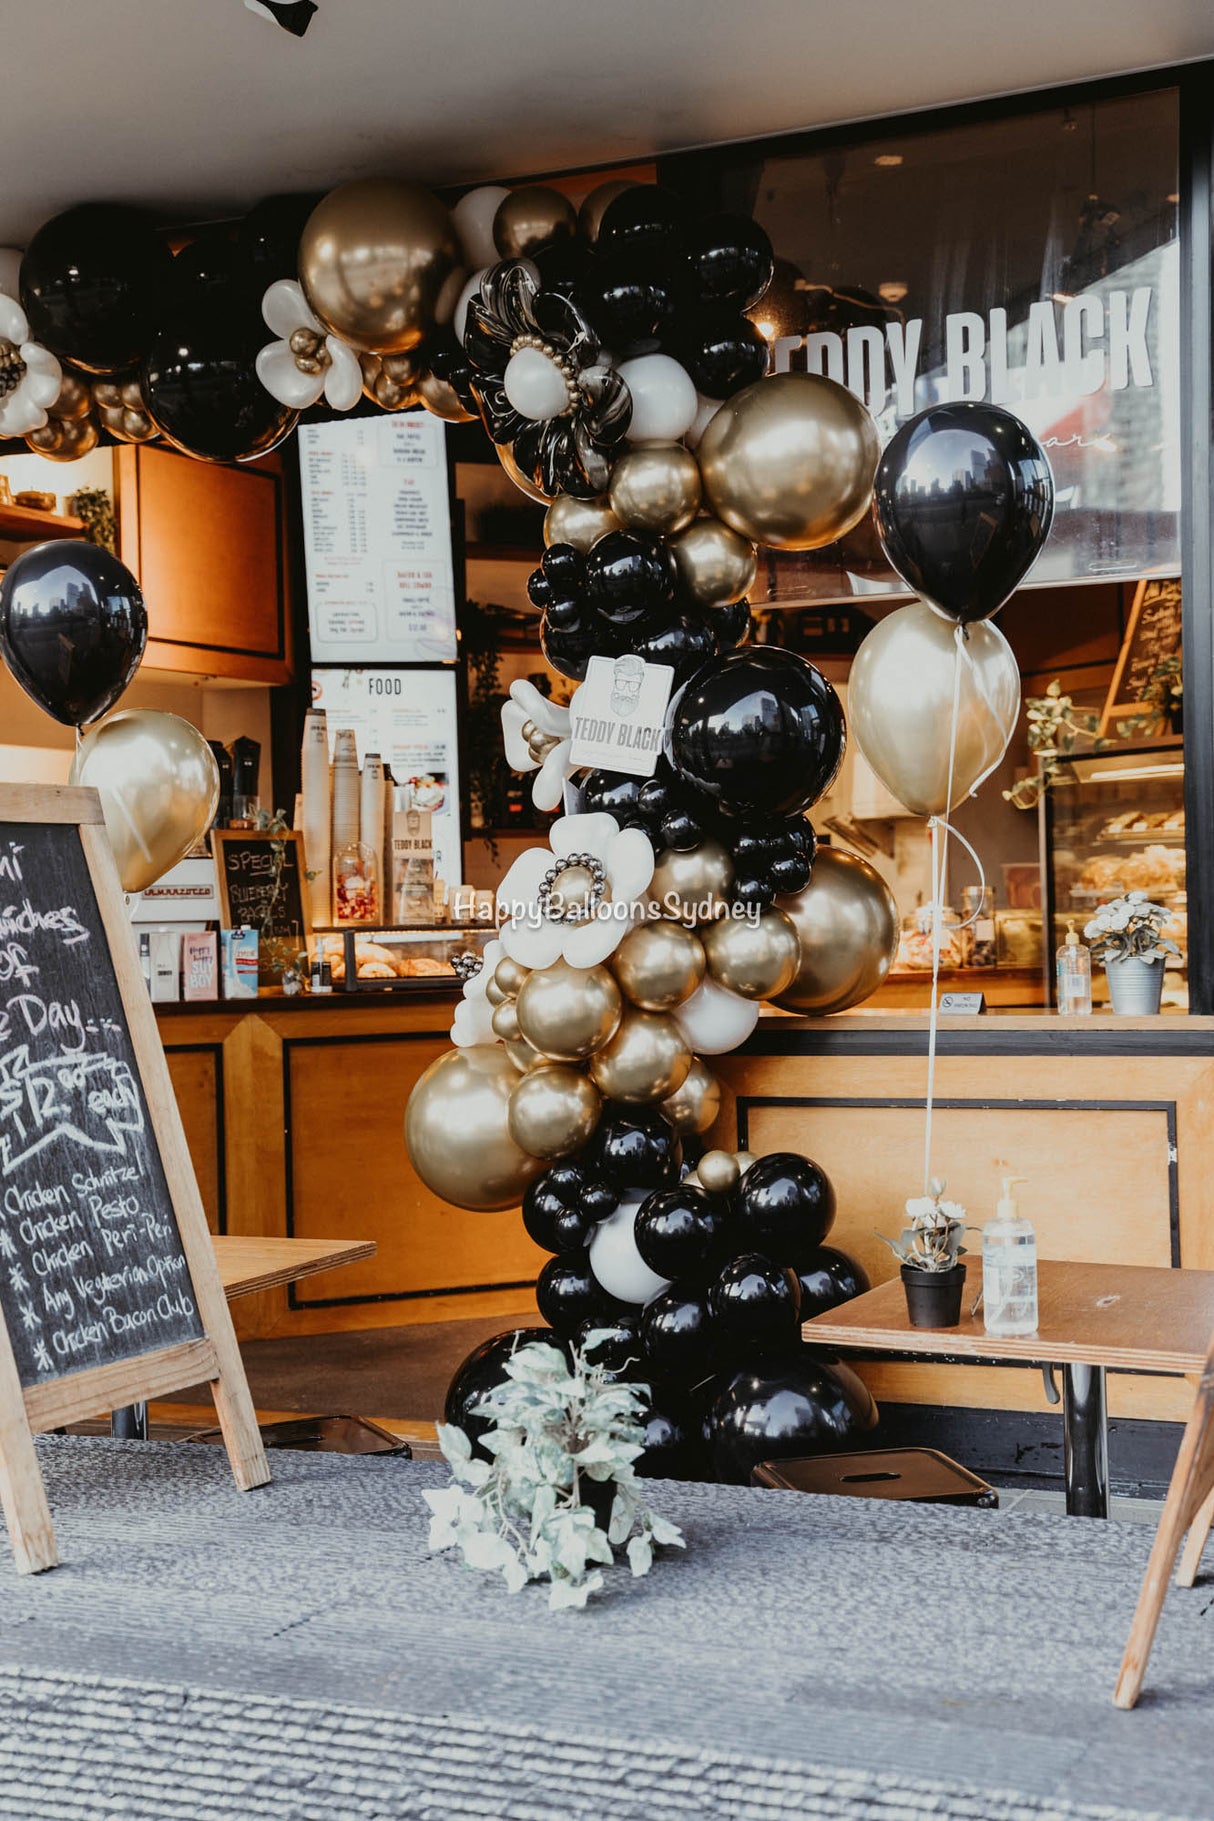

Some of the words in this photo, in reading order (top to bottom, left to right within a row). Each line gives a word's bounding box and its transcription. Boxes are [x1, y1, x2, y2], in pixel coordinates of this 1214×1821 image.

[946, 286, 1154, 404] BLACK
[368, 678, 401, 695] FOOD
[574, 716, 616, 745] TEDDY
[616, 722, 662, 752] BLACK
[228, 851, 294, 871] SPECIL
[394, 839, 411, 849] TEDDY
[414, 839, 432, 849] BLACK
[4, 1180, 71, 1215] Chicken
[19, 1211, 84, 1246] Chicken
[88, 1194, 140, 1229] Pesto
[32, 1240, 95, 1276] Chicken
[43, 1282, 75, 1320] Any
[146, 1254, 186, 1290] Option
[52, 1320, 109, 1355] Chicken
[102, 1306, 158, 1334] Bacon
[156, 1287, 195, 1319] Club
